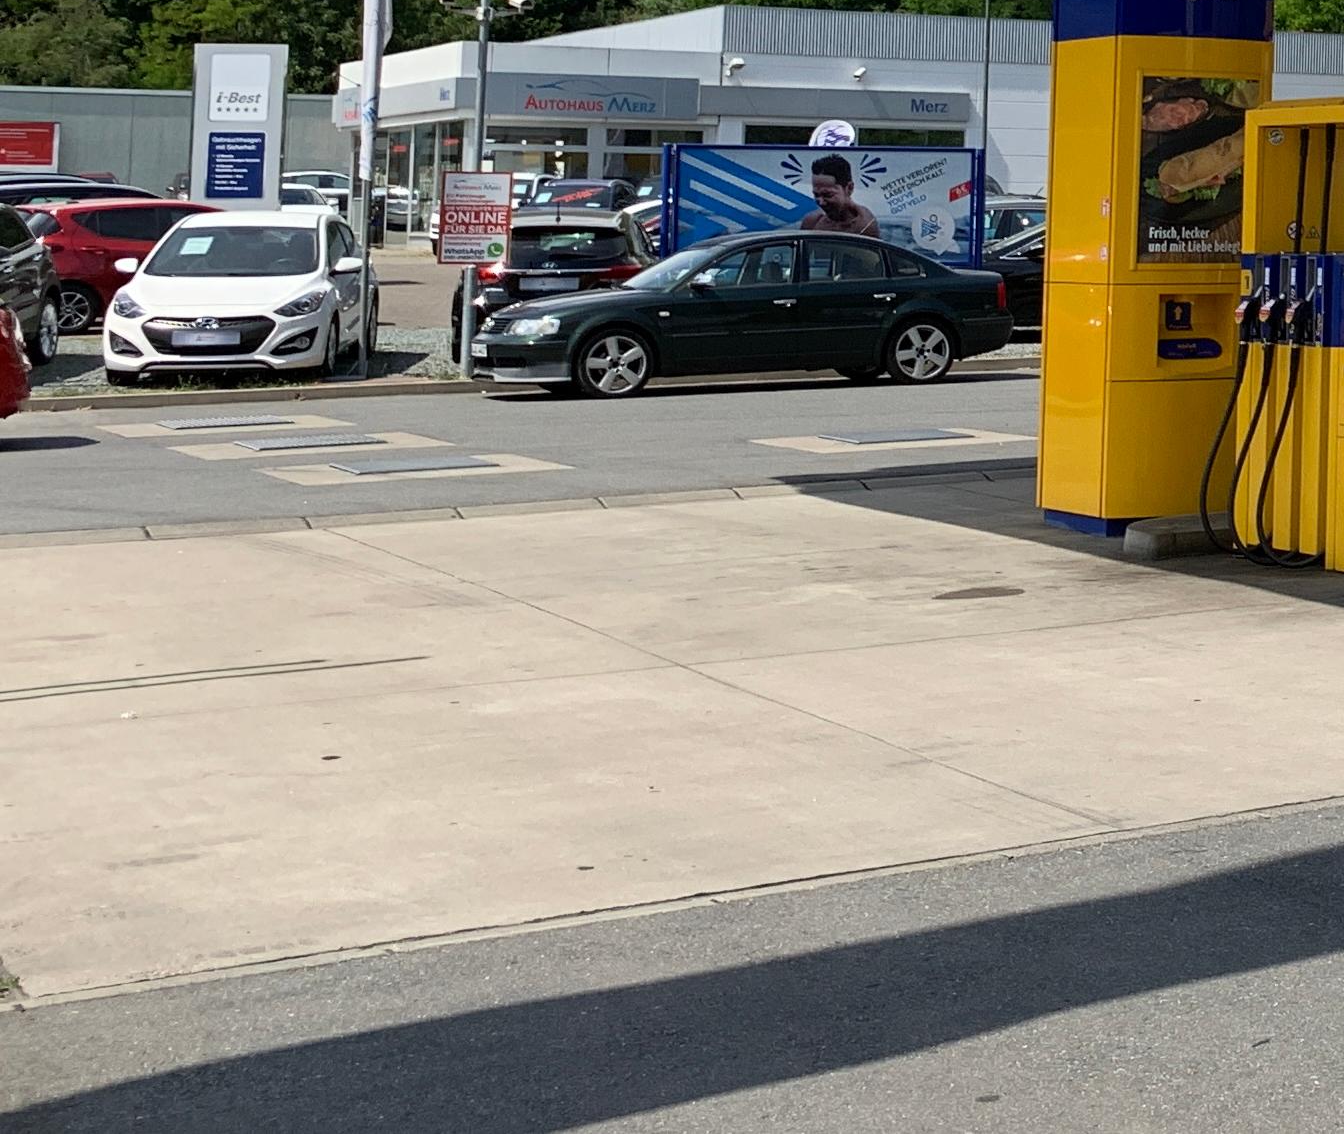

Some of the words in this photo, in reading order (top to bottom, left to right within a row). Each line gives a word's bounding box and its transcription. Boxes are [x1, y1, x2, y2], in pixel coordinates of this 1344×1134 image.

[216, 92, 262, 104] i-Best
[524, 94, 604, 112] AUTOHAUS
[607, 97, 657, 113] MERZ
[911, 98, 949, 114] Merz
[880, 175, 907, 192] WETTE
[445, 211, 508, 224] ONLINE
[444, 223, 466, 234] FÜR
[468, 226, 485, 234] SIE
[487, 225, 507, 234] DA!
[1149, 227, 1180, 240] Frisch,
[1182, 227, 1210, 239] lecker
[1148, 241, 1168, 253] und
[1169, 241, 1186, 252] mit
[1188, 241, 1213, 253] Liebe
